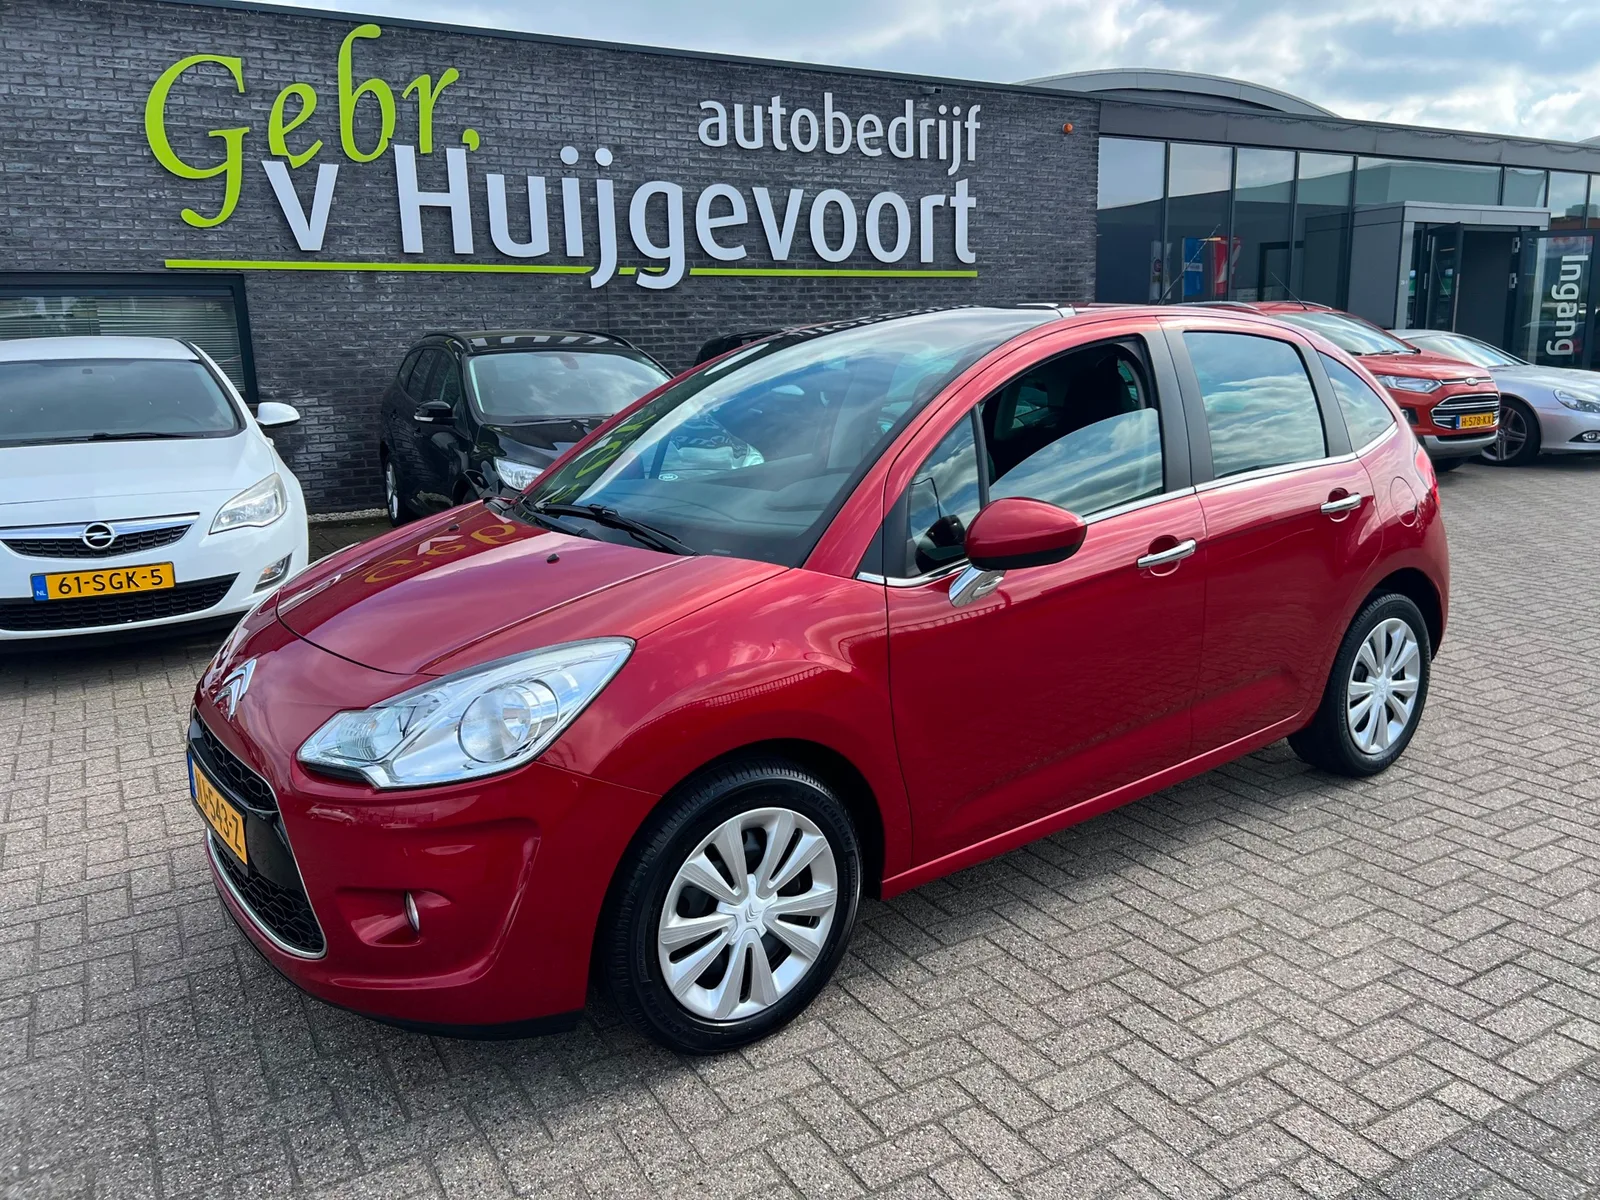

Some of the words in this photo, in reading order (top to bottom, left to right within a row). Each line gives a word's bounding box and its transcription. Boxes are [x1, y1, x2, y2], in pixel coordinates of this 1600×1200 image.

[699, 92, 981, 176] autobedrijf
[261, 160, 339, 251] v
[394, 144, 977, 289] Huijgevoort
[1546, 254, 1589, 356] Ingang
[1461, 414, 1492, 427] H-578-KX
[58, 568, 163, 595] 61-SGK-5
